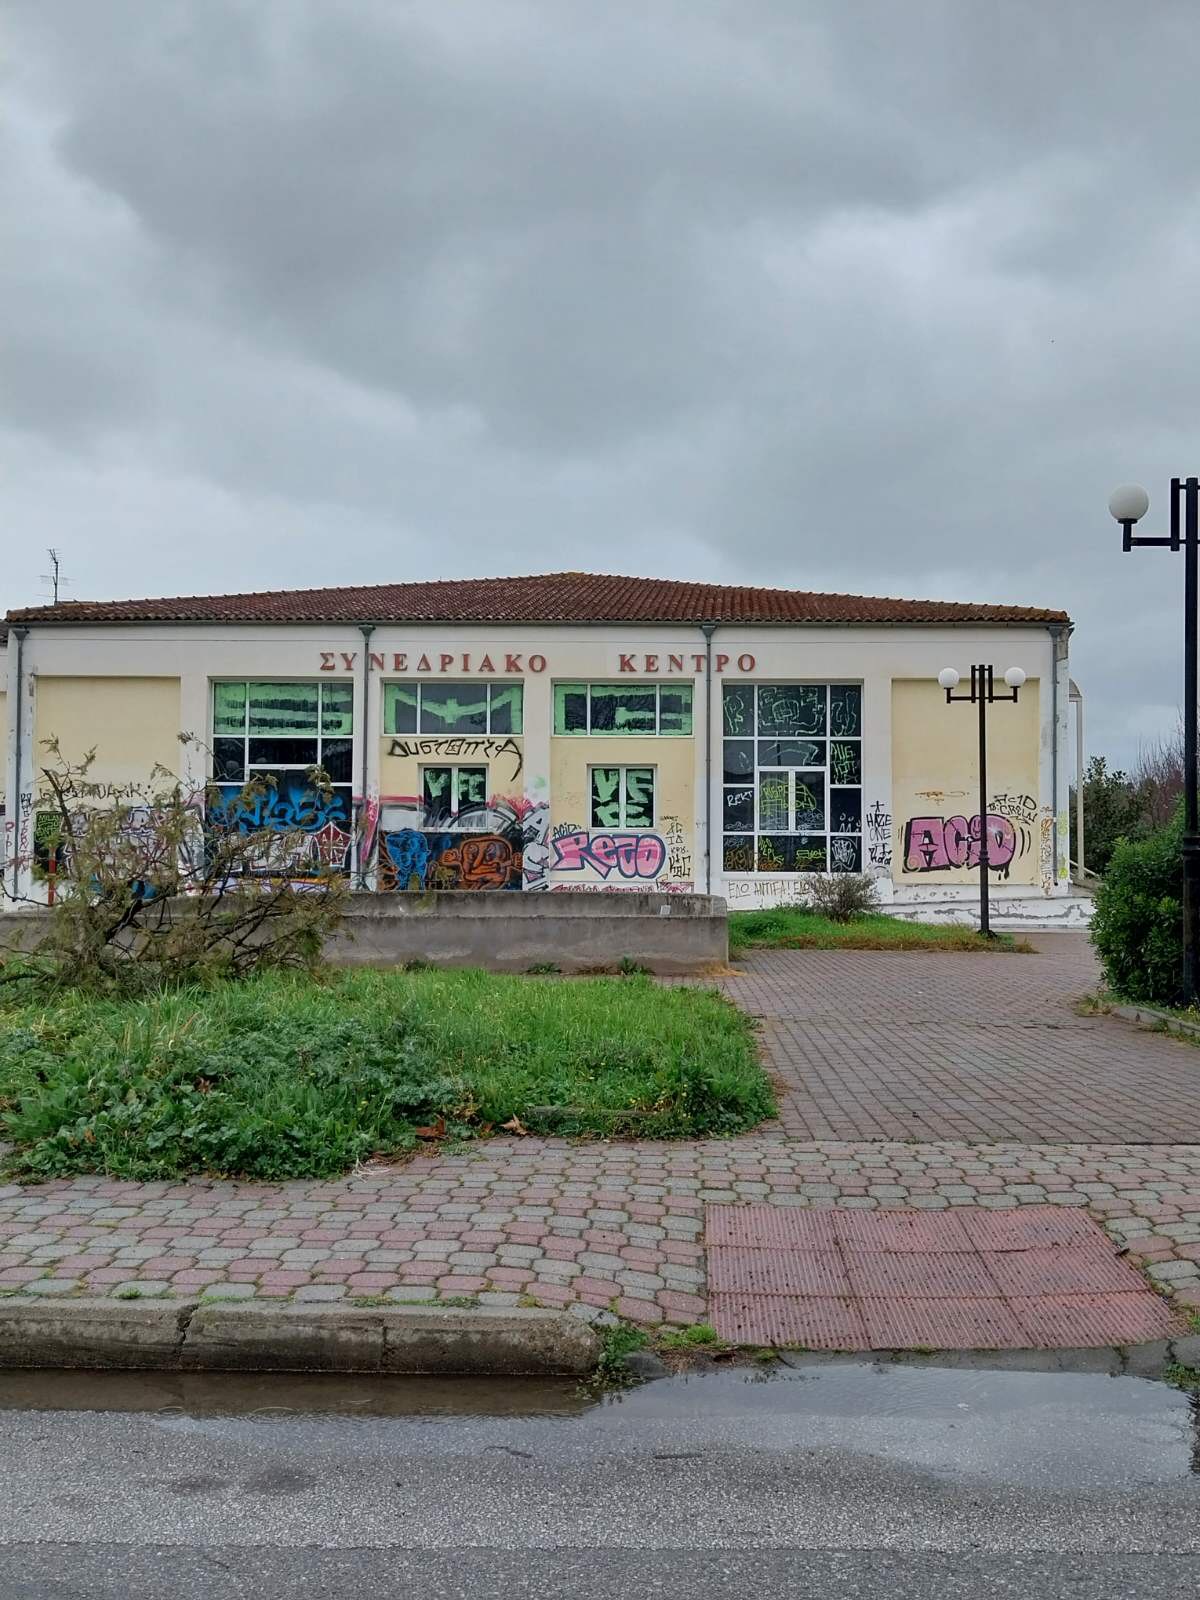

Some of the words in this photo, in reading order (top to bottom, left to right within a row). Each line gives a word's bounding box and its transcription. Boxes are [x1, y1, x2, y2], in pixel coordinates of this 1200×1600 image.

[319, 652, 547, 673] ΣΥΝΕΔΡΙΑΚΟ
[618, 654, 756, 673] ΚΕΝΤΡΟ
[866, 812, 892, 828] HAZE
